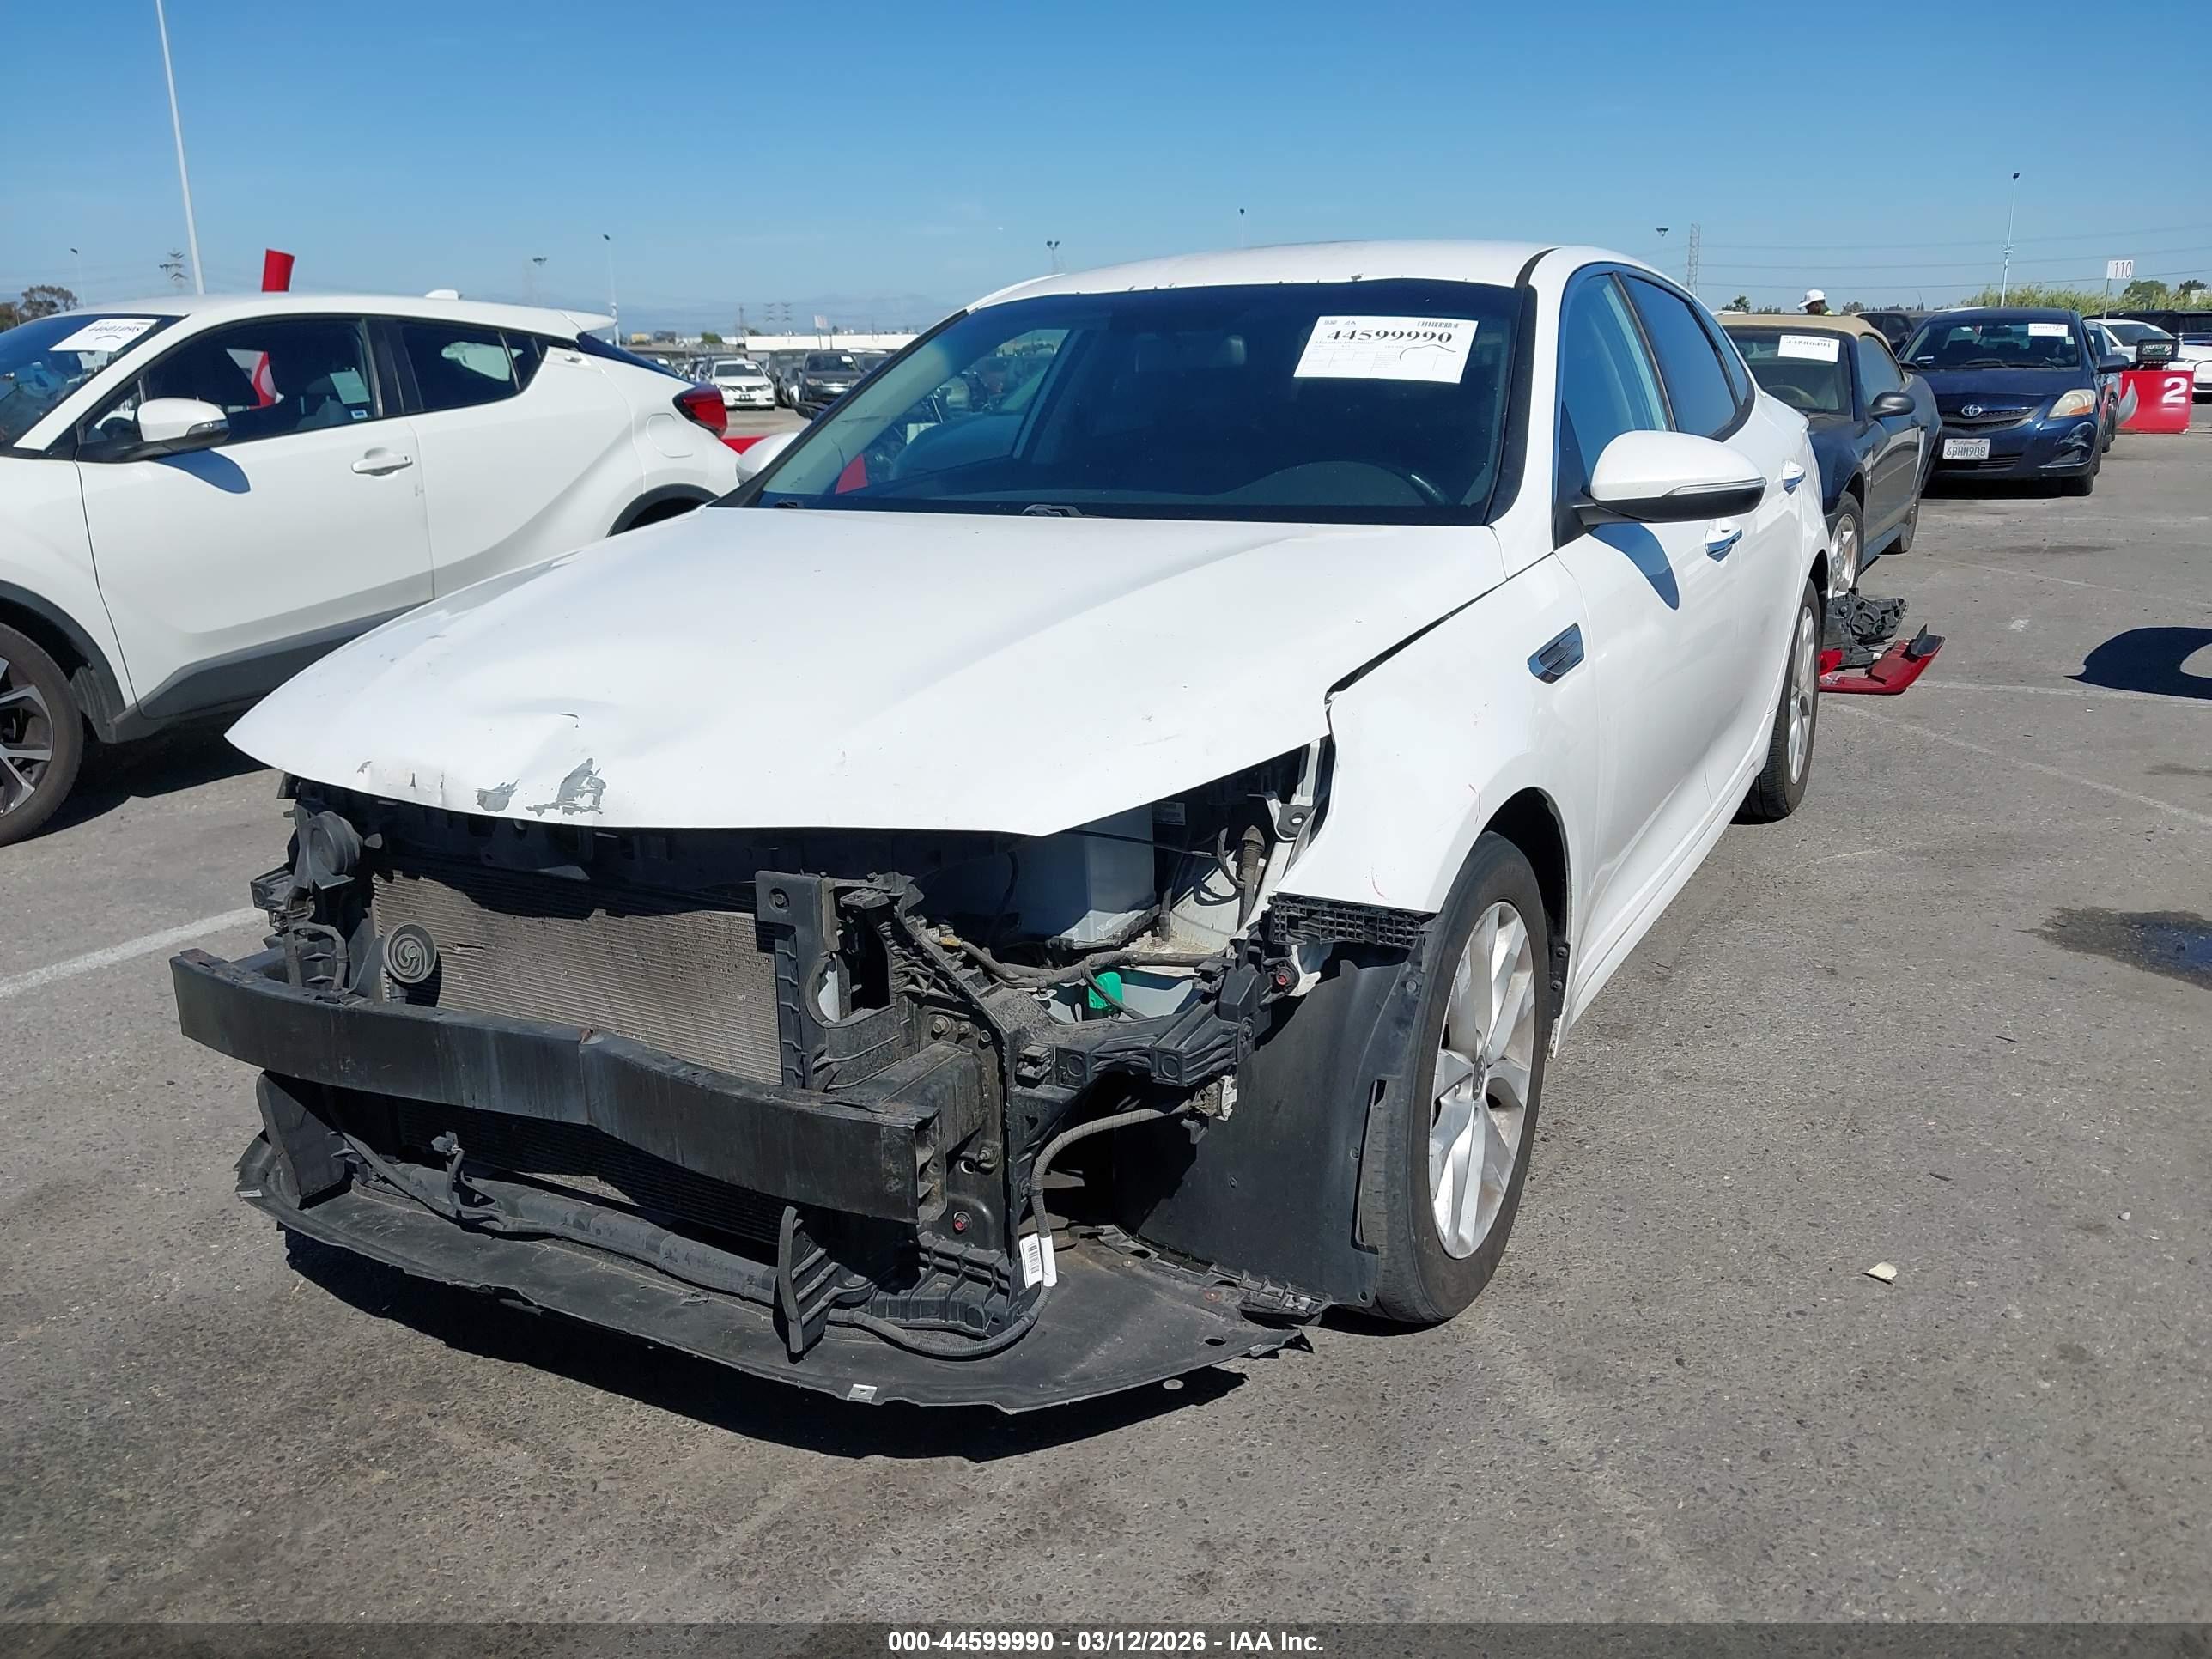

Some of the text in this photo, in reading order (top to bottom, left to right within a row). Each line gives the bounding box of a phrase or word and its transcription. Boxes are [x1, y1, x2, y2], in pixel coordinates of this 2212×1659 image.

[2114, 260, 2132, 278] 110
[1327, 329, 1453, 343] 44599990
[2162, 376, 2188, 404] 2
